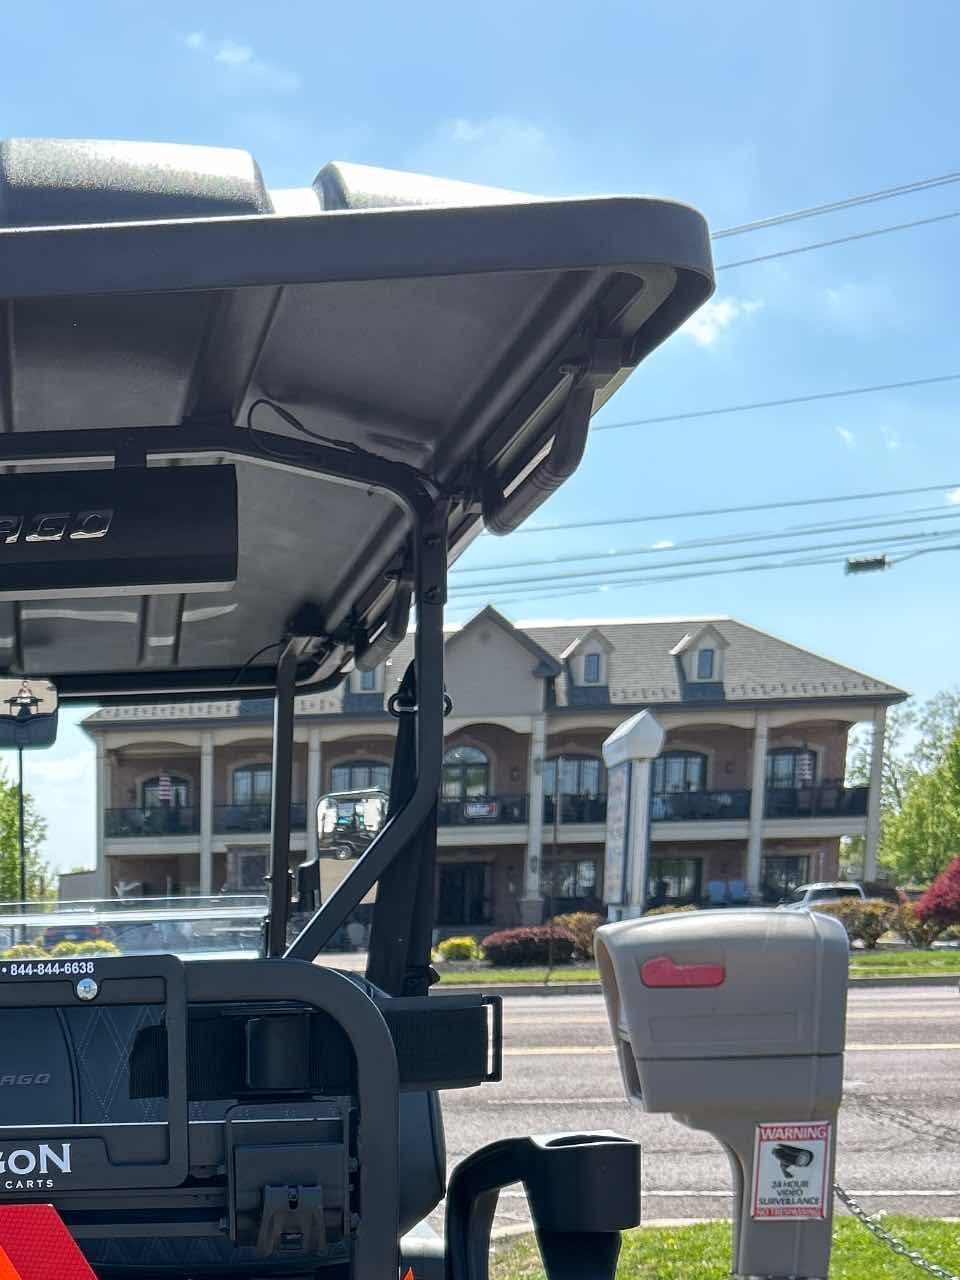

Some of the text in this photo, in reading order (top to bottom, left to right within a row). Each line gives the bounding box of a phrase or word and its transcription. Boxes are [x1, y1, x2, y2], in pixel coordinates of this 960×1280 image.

[10, 962, 95, 976] 844-844-6638
[760, 1127, 827, 1139] WARNING
[5, 1179, 54, 1189] CARTS
[783, 1180, 809, 1188] HOUR
[776, 1188, 804, 1196] VIDEO
